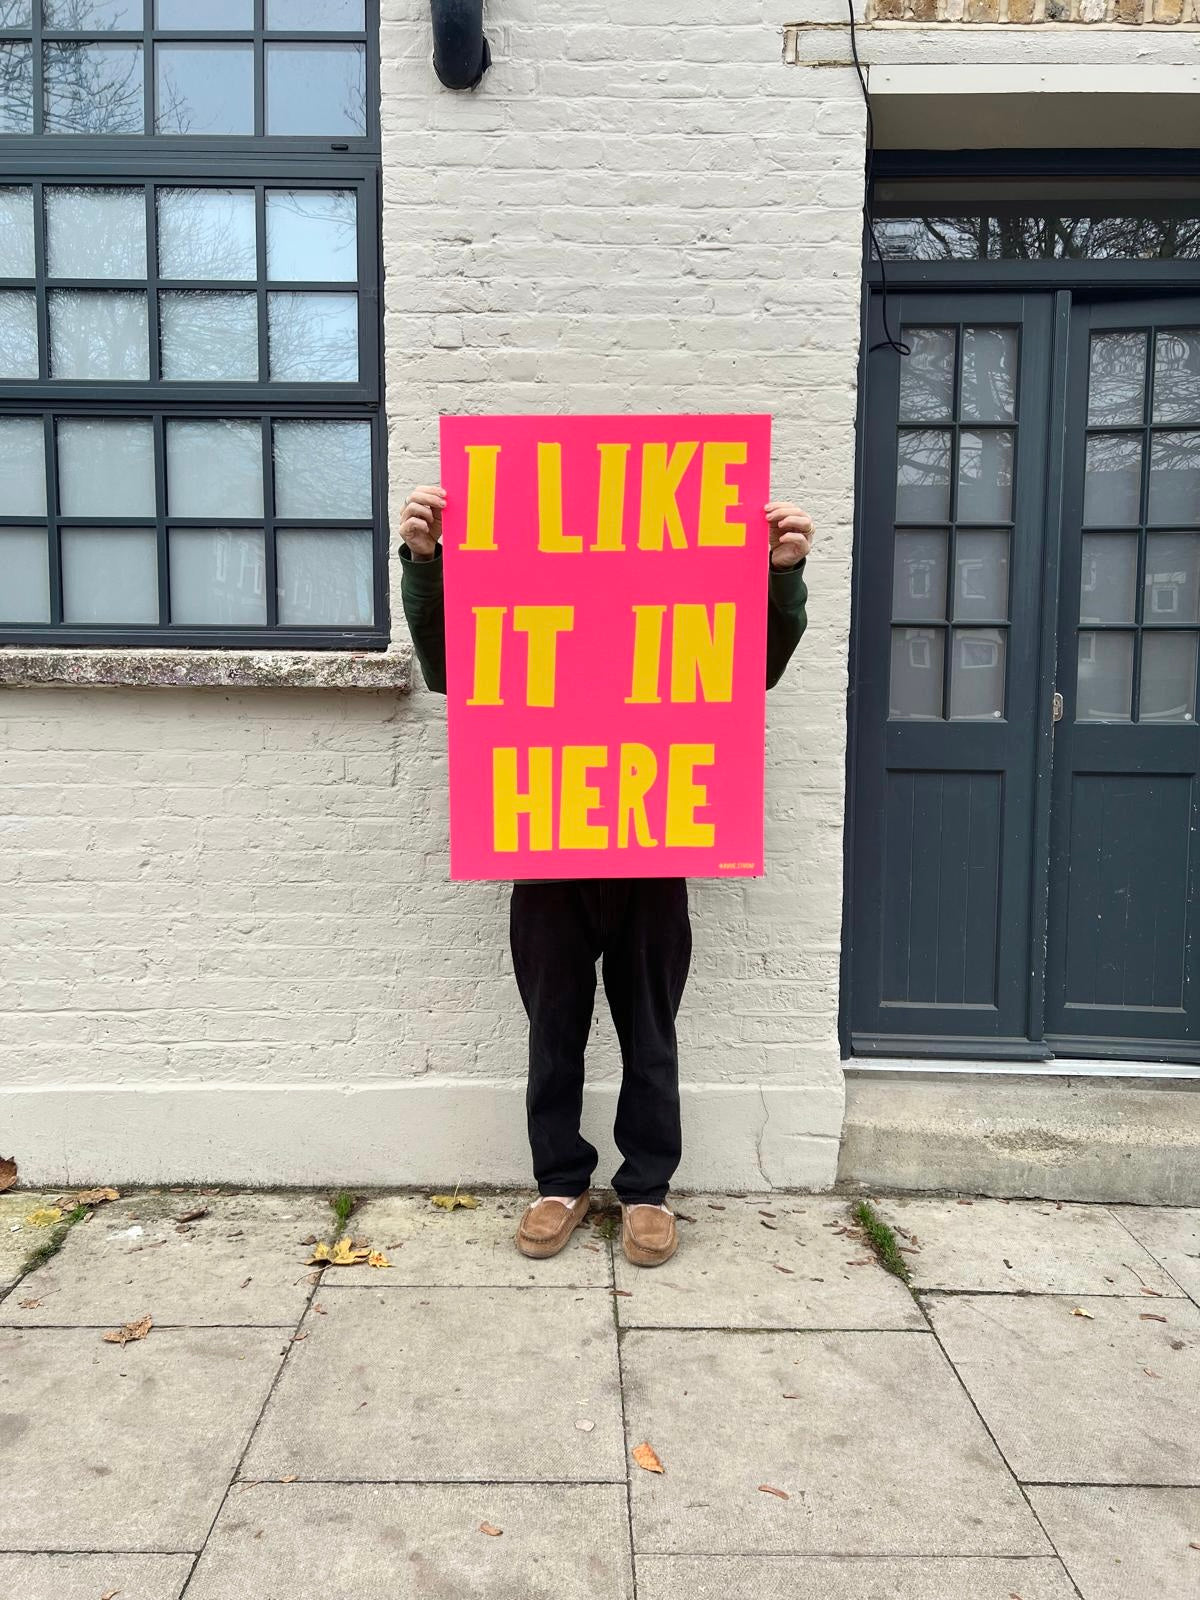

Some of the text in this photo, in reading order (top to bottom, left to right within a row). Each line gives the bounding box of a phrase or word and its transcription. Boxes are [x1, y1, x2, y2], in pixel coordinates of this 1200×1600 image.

[459, 441, 748, 554] I LIKE
[466, 602, 736, 707] IT IN
[492, 743, 716, 853] HERE
